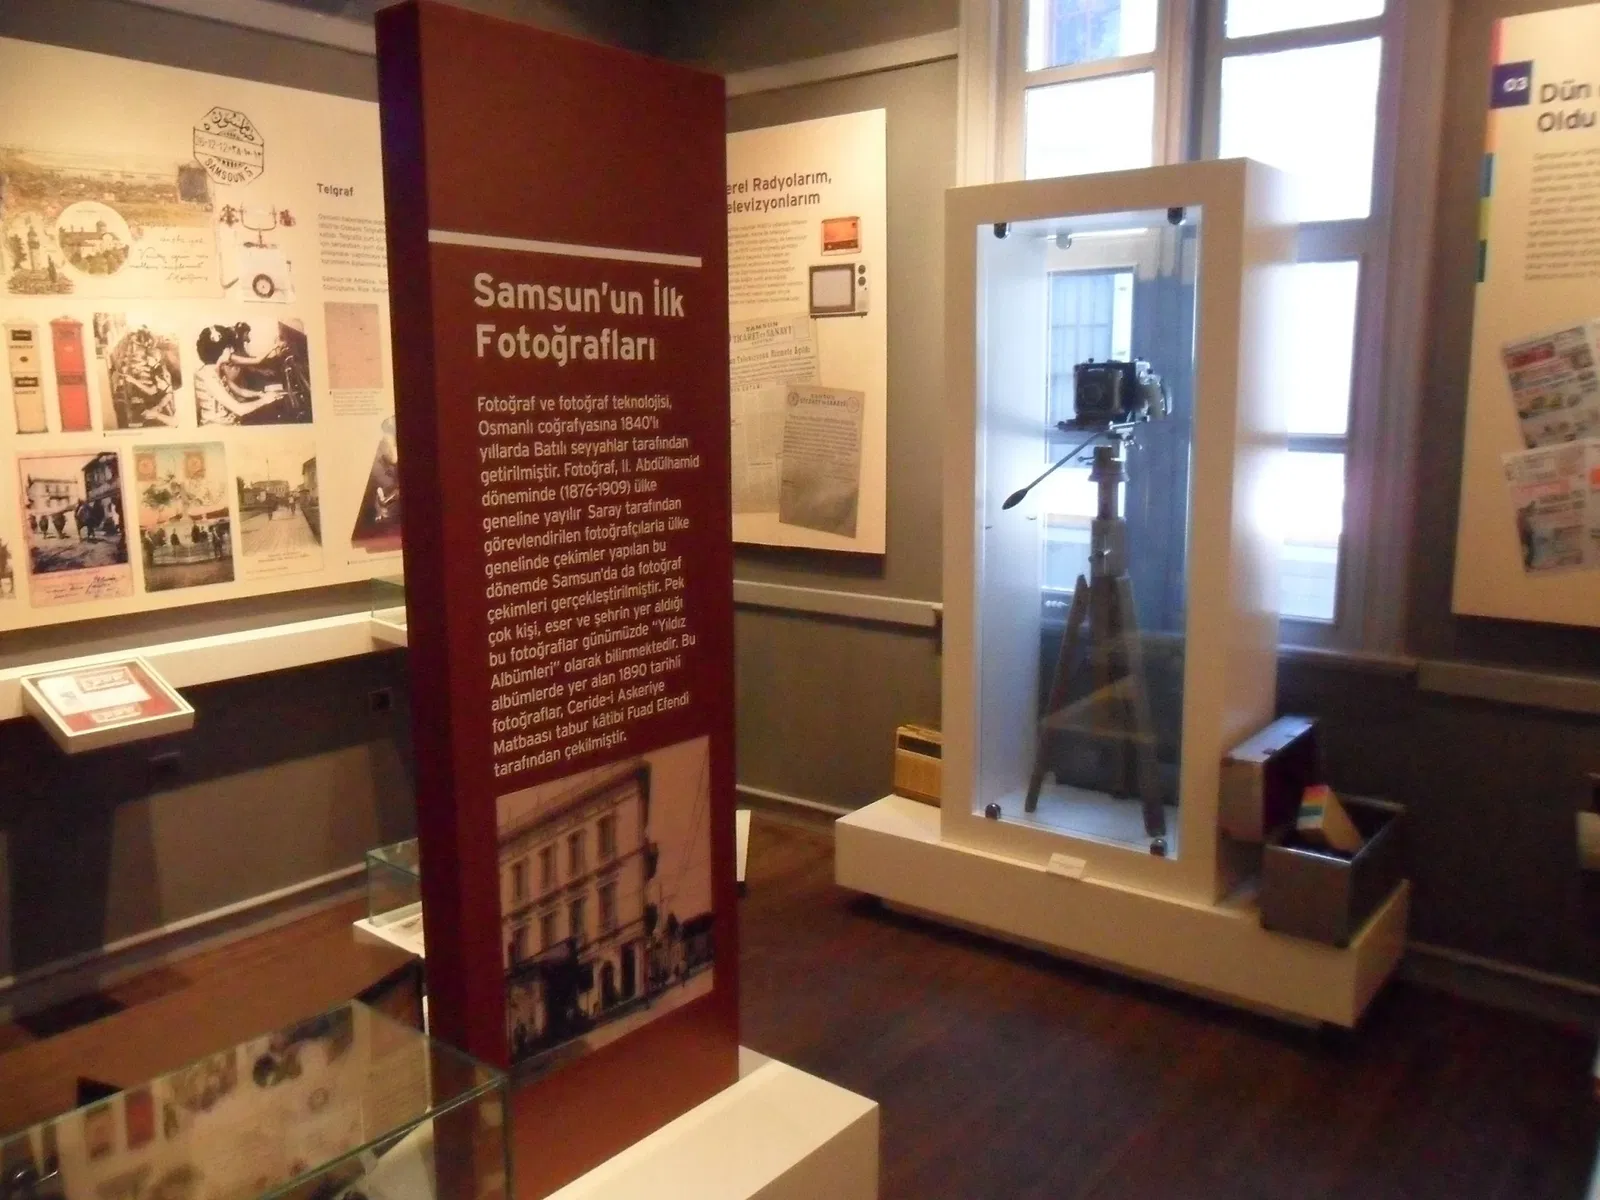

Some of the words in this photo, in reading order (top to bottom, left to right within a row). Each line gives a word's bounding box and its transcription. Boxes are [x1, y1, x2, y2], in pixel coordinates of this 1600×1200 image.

[1503, 77, 1528, 92] 03
[1540, 79, 1592, 104] Dün
[1537, 109, 1597, 132] Oldu
[205, 158, 245, 182] SAMSOUN
[727, 180, 748, 194] erel
[753, 172, 831, 191] Radyolarım,
[316, 183, 354, 197] Telgraf
[727, 193, 820, 213] elevizyonlarım
[474, 272, 643, 315] Samsun'un
[653, 278, 685, 317] İlk
[476, 324, 655, 367] Fotoğrafları
[477, 396, 536, 414] Fotoğraf
[540, 398, 555, 412] ve
[559, 395, 609, 413] fotoğraf
[612, 395, 672, 412] teknolojisi,
[478, 418, 533, 435] Osmanlı
[538, 418, 617, 436] coğrafyasına
[620, 416, 659, 430] 1840'lı
[480, 443, 529, 463] yıllarda
[534, 441, 566, 457] Batılı
[571, 438, 629, 456] seyyahlar
[632, 436, 688, 451] tarafından
[481, 464, 560, 486] getirilmiştir.
[564, 460, 618, 478] Fotoğraf,
[636, 455, 699, 472] Abdülhamid
[482, 486, 556, 507] döneminde
[560, 480, 630, 500] (1876-1909)
[635, 479, 657, 493] ülke
[483, 511, 539, 533] geneline
[588, 504, 621, 520] Saray
[626, 497, 681, 514] tarafından
[484, 529, 581, 554] görevlendirilen
[584, 518, 664, 540] fotoğrafçılarla
[669, 517, 689, 530] ülke
[485, 555, 549, 578] genelinde
[553, 548, 605, 570] çekimler
[609, 541, 649, 562] yapılan
[653, 540, 666, 552] bu
[486, 578, 548, 598] dönemde
[552, 567, 618, 588] Samsun'da
[621, 564, 635, 578] da
[639, 556, 682, 575] fotoğraf
[487, 597, 547, 624] çekimleri
[551, 583, 662, 612] gerçekleştirilmiştir.
[665, 576, 684, 591] Pek
[488, 627, 511, 647] çok
[516, 621, 541, 640] kişi,
[545, 618, 572, 633] eser
[577, 613, 590, 627] ve
[594, 606, 630, 625] şehrin
[634, 602, 651, 620] yer
[655, 597, 683, 615] aldığı
[490, 652, 506, 667] bu
[510, 637, 578, 662] fotoğraflar
[582, 624, 648, 650] günümüzde
[564, 654, 601, 673] olarak
[605, 638, 678, 663] bilinmektedir.
[681, 633, 696, 647] Bu
[491, 683, 564, 711] albümlerde
[568, 678, 587, 695] yer
[591, 672, 615, 689] alan
[619, 662, 646, 681] 1890
[650, 655, 681, 674] tarihli
[492, 705, 564, 734] fotoğraflar,
[568, 691, 613, 715] Ceride-i
[618, 680, 664, 702] Askeriye
[493, 729, 552, 755] Matbaası
[556, 719, 588, 739] tabur
[592, 708, 624, 728] kâtibi
[627, 703, 653, 721] Fuad
[657, 692, 690, 712] Efendi
[494, 749, 560, 777] tarafından
[565, 731, 627, 760] çekilmiştir.
